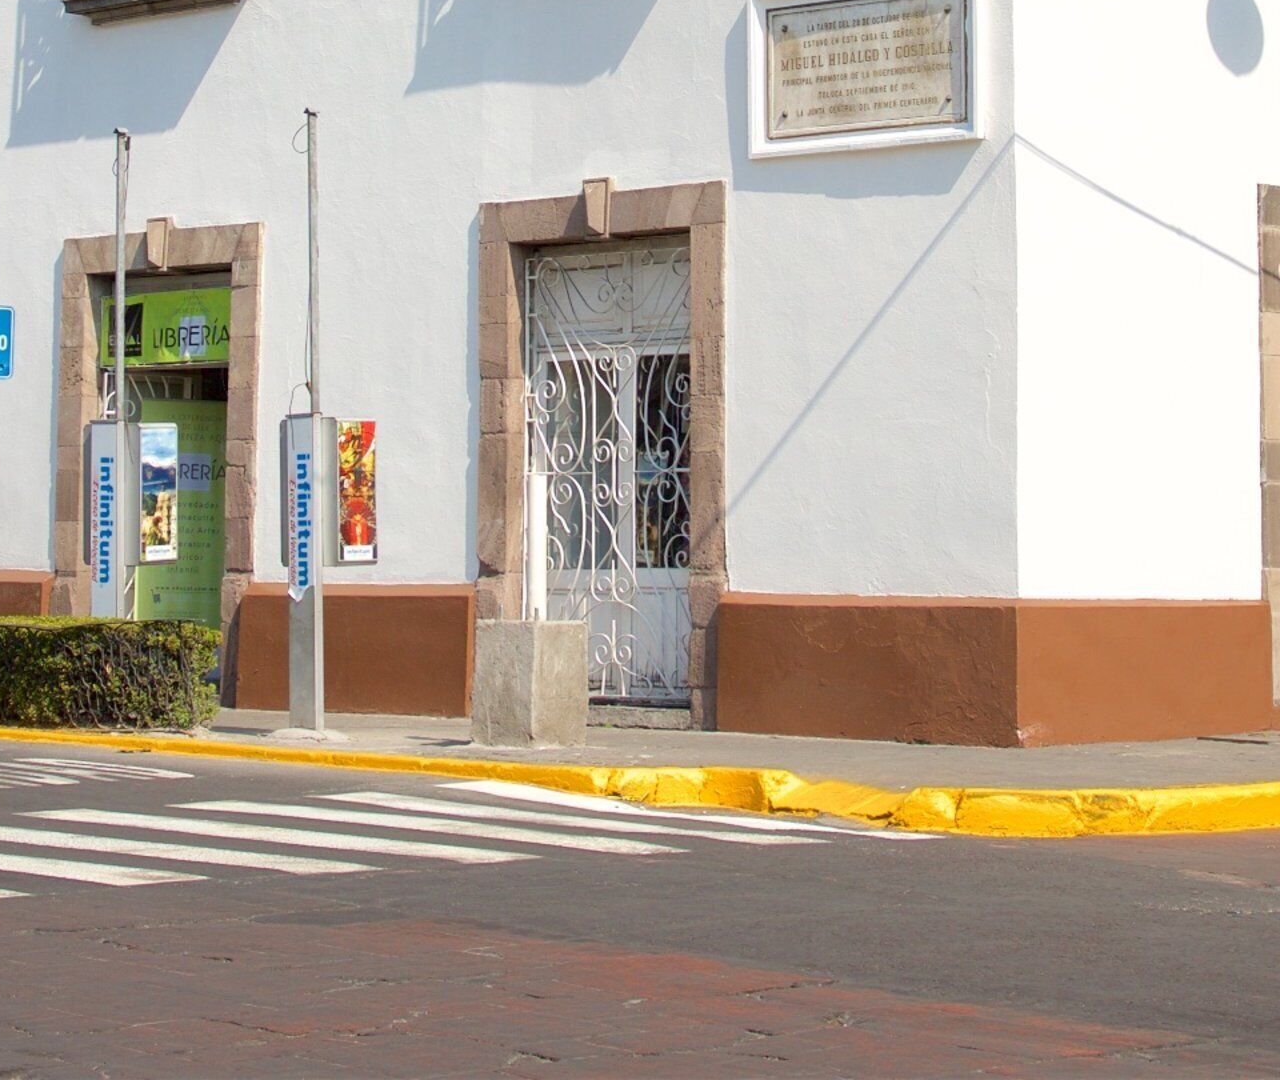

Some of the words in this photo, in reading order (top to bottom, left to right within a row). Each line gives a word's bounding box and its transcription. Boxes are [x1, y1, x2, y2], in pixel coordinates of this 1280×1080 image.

[781, 55, 824, 71] MIGUEL
[828, 48, 880, 66] HIDALGO
[884, 47, 890, 60] Y
[152, 317, 230, 349] LIBRERÍA
[179, 459, 226, 480] RERÍA
[100, 456, 114, 583] infinitum
[297, 453, 311, 587] infinitum
